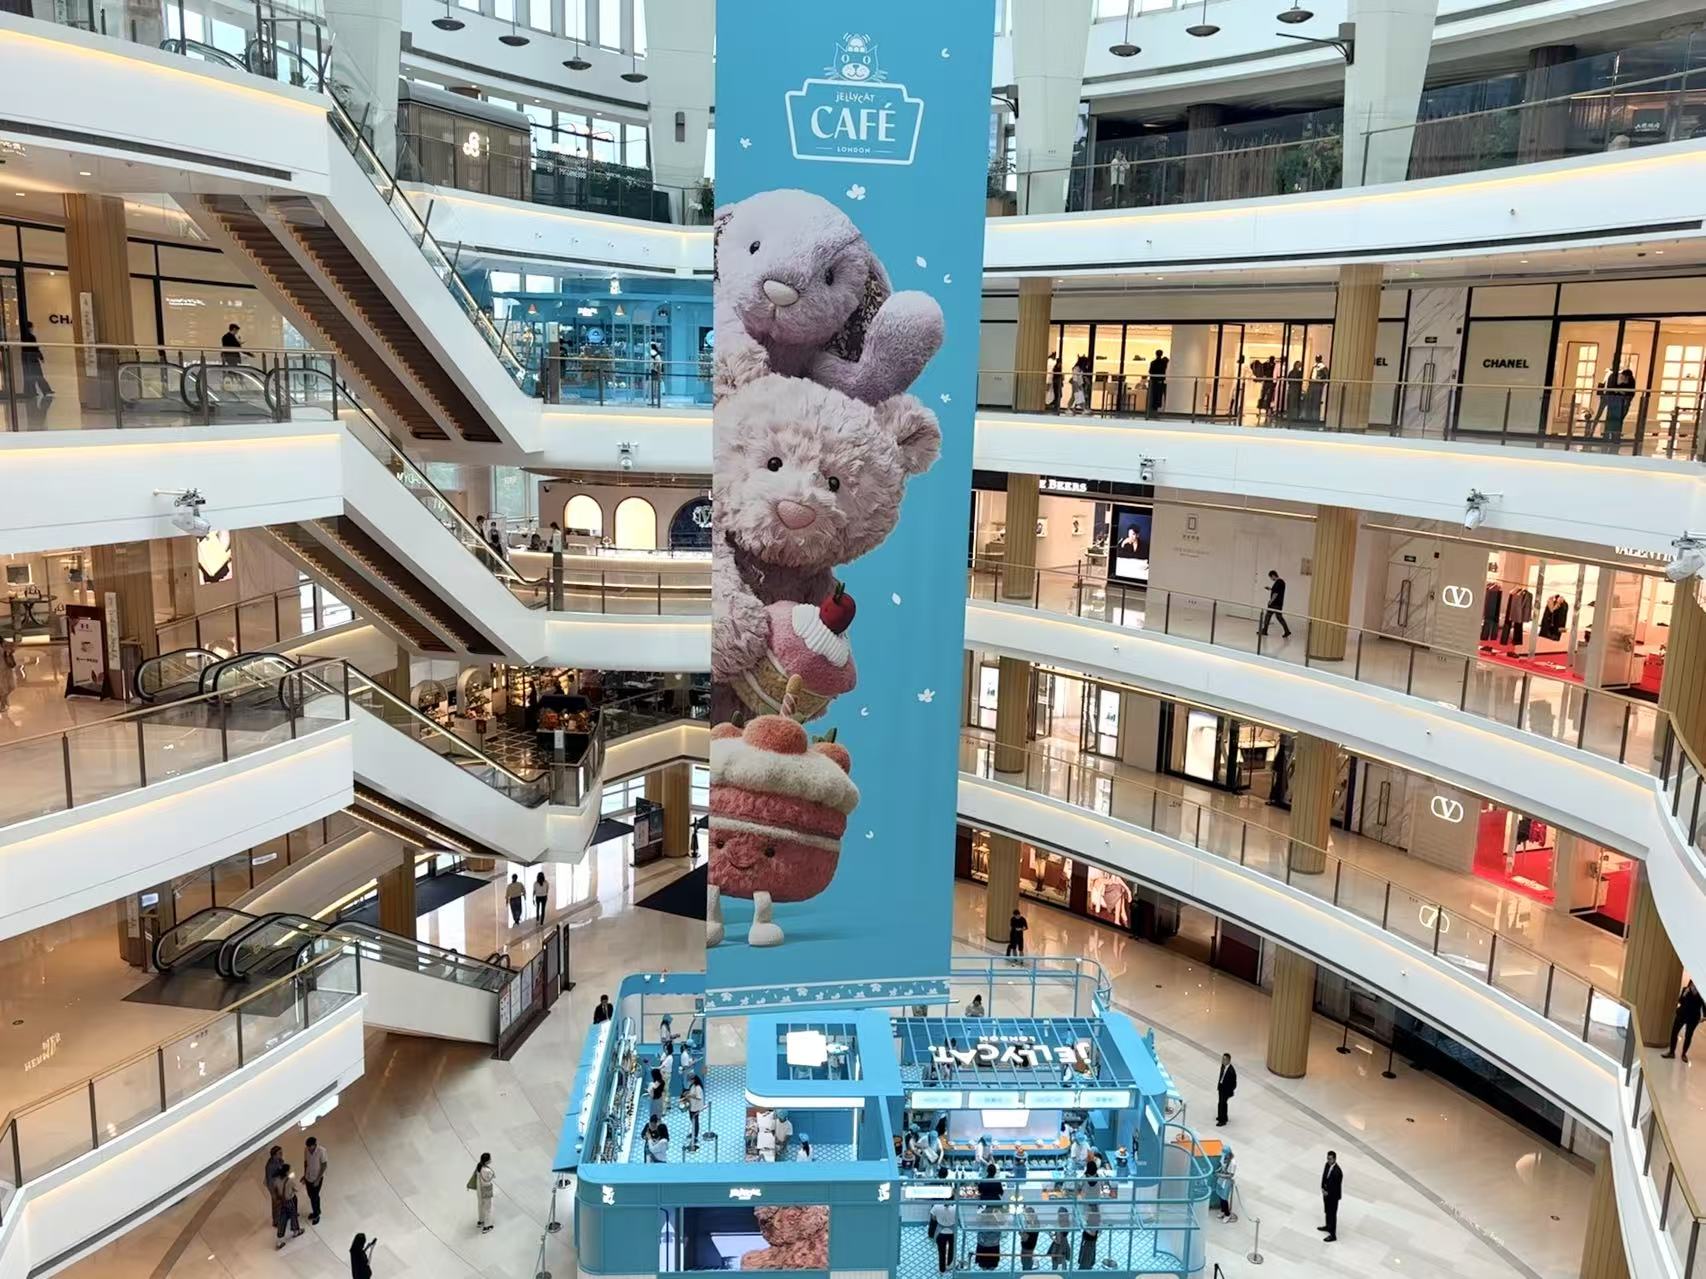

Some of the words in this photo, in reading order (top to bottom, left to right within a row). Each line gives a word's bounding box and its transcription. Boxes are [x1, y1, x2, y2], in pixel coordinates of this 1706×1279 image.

[811, 102, 896, 142] CAFÉ
[837, 146, 871, 154] LONDON
[1482, 358, 1530, 369] CHANEL
[1048, 479, 1087, 493] BEERS
